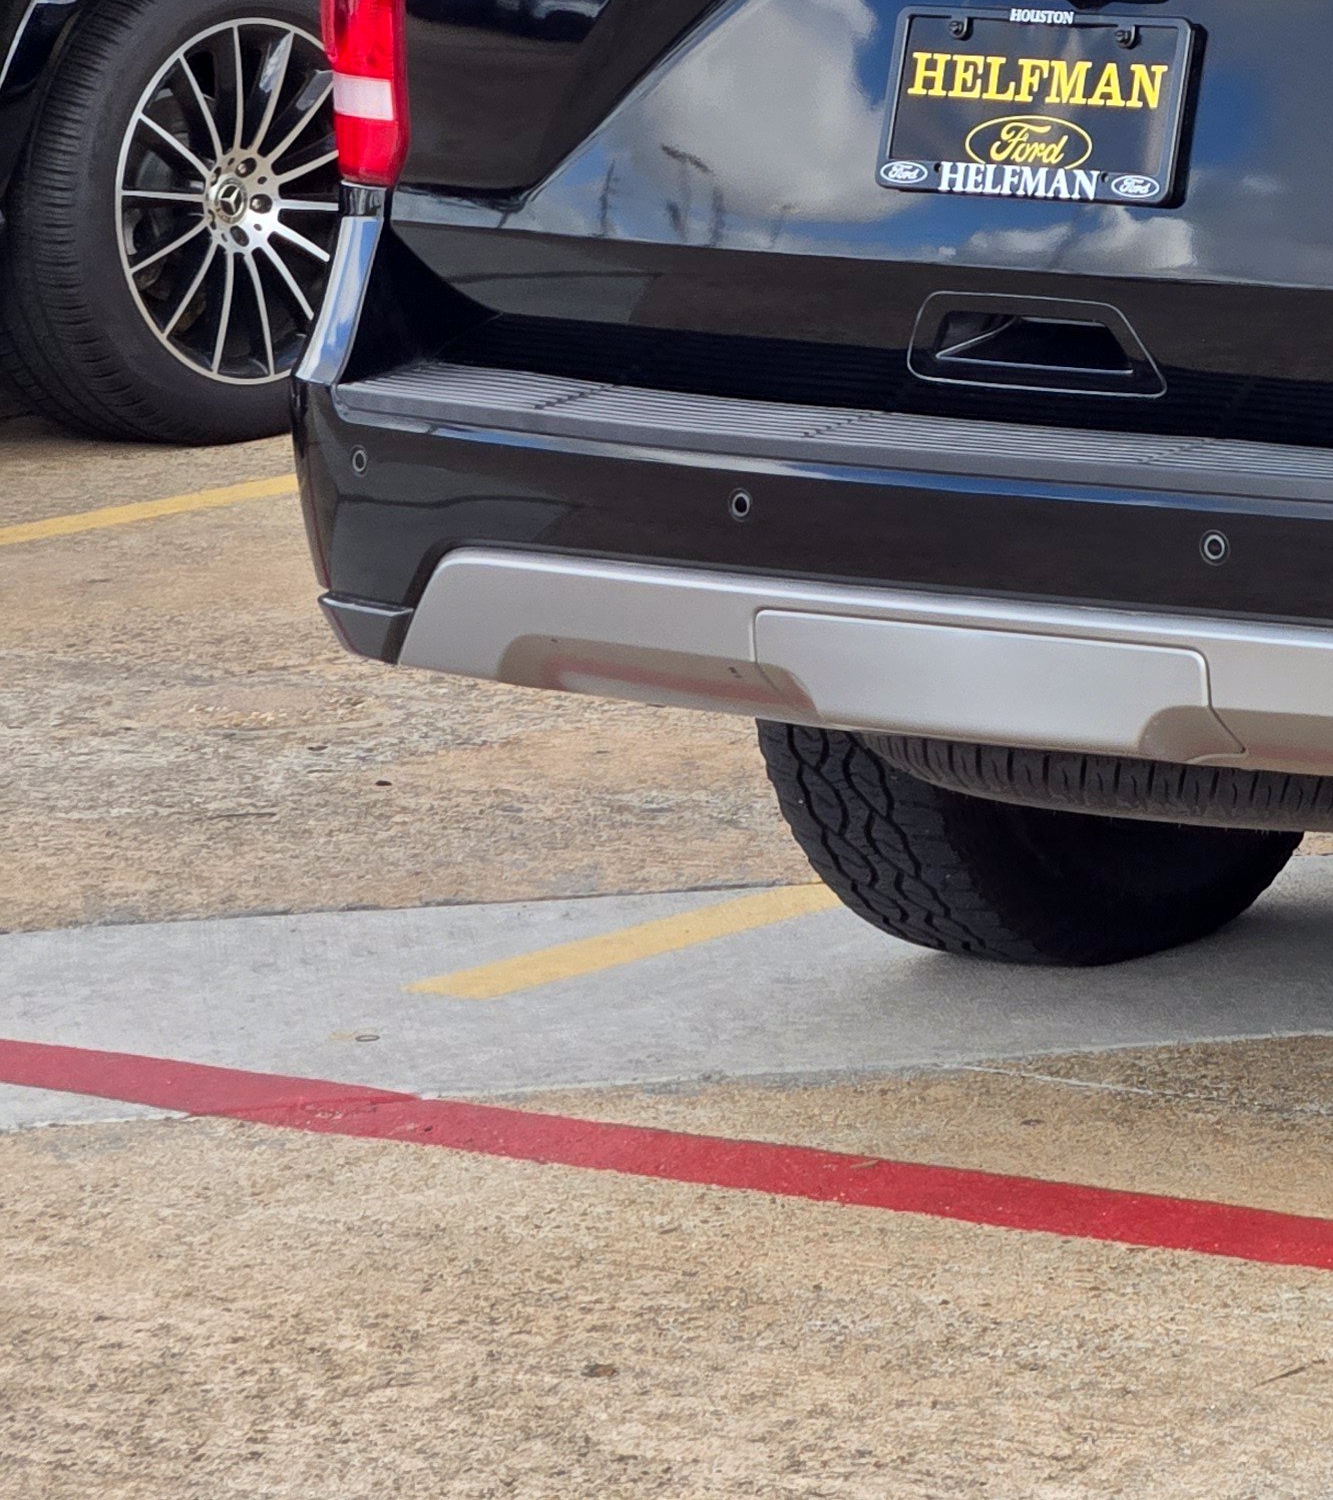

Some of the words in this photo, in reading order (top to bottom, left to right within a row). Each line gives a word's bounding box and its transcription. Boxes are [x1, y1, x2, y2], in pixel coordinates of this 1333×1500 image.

[1010, 8, 1075, 25] HOUSTON
[907, 51, 1169, 109] HELFMAN
[990, 121, 1069, 164] Ford
[938, 161, 1101, 200] HELFMAN
